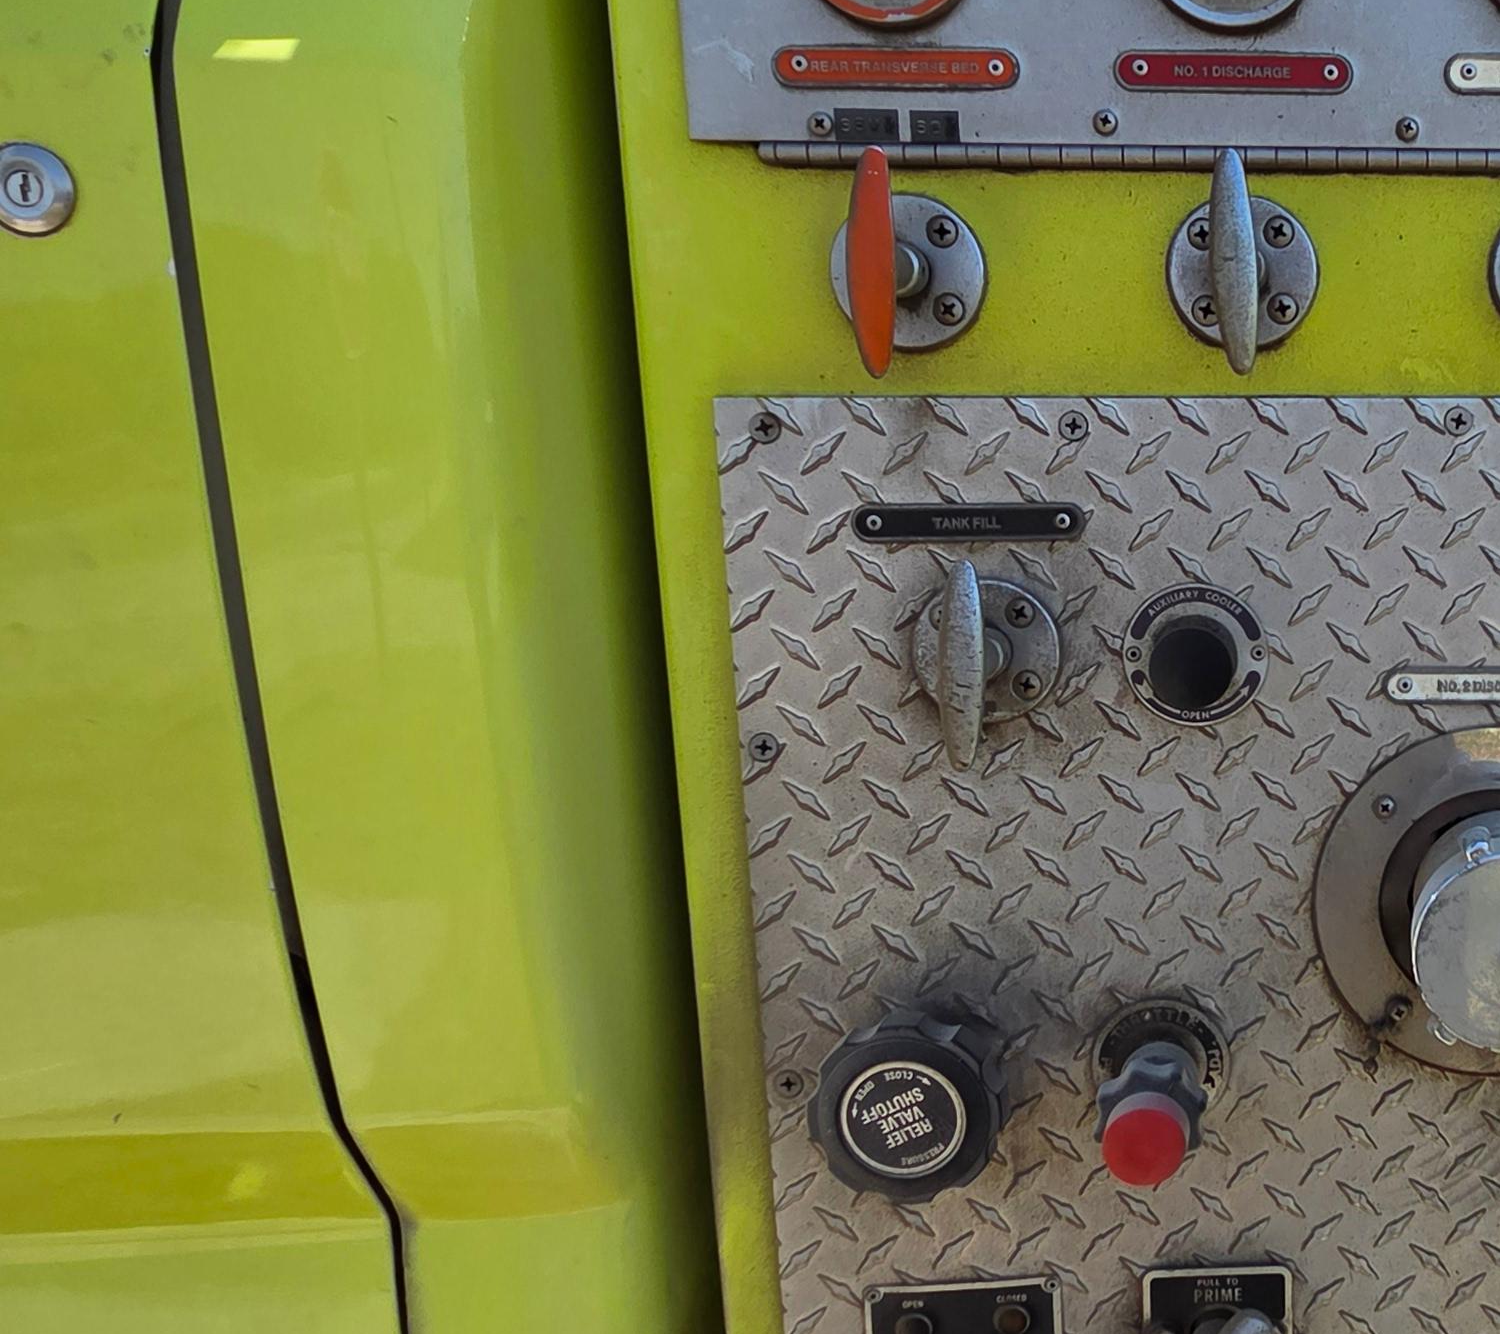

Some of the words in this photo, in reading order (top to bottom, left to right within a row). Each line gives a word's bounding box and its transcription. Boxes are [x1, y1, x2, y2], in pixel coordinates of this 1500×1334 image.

[811, 59, 849, 73] REAR
[853, 60, 948, 74] TRANSVERSE
[951, 61, 980, 75] BED
[1173, 64, 1198, 78] NO.
[1212, 65, 1292, 79] DISCHARGE
[931, 516, 971, 530] TANK
[973, 516, 1001, 530] FILL
[1147, 589, 1200, 618] AUXILIARY
[1204, 590, 1244, 616] COOLER
[1436, 679, 1461, 694] NO.
[1180, 709, 1211, 721] OPEN
[884, 1070, 914, 1082] CLOSE
[861, 1087, 925, 1125] SHUTOFF
[877, 1106, 925, 1135] VALVE
[885, 1118, 933, 1150] RELIEF
[1196, 1277, 1221, 1287] PULL
[1226, 1277, 1239, 1286] TO
[996, 1293, 1028, 1304] CLOSED
[1193, 1287, 1243, 1303] PRIME
[902, 1299, 924, 1309] OPEN
